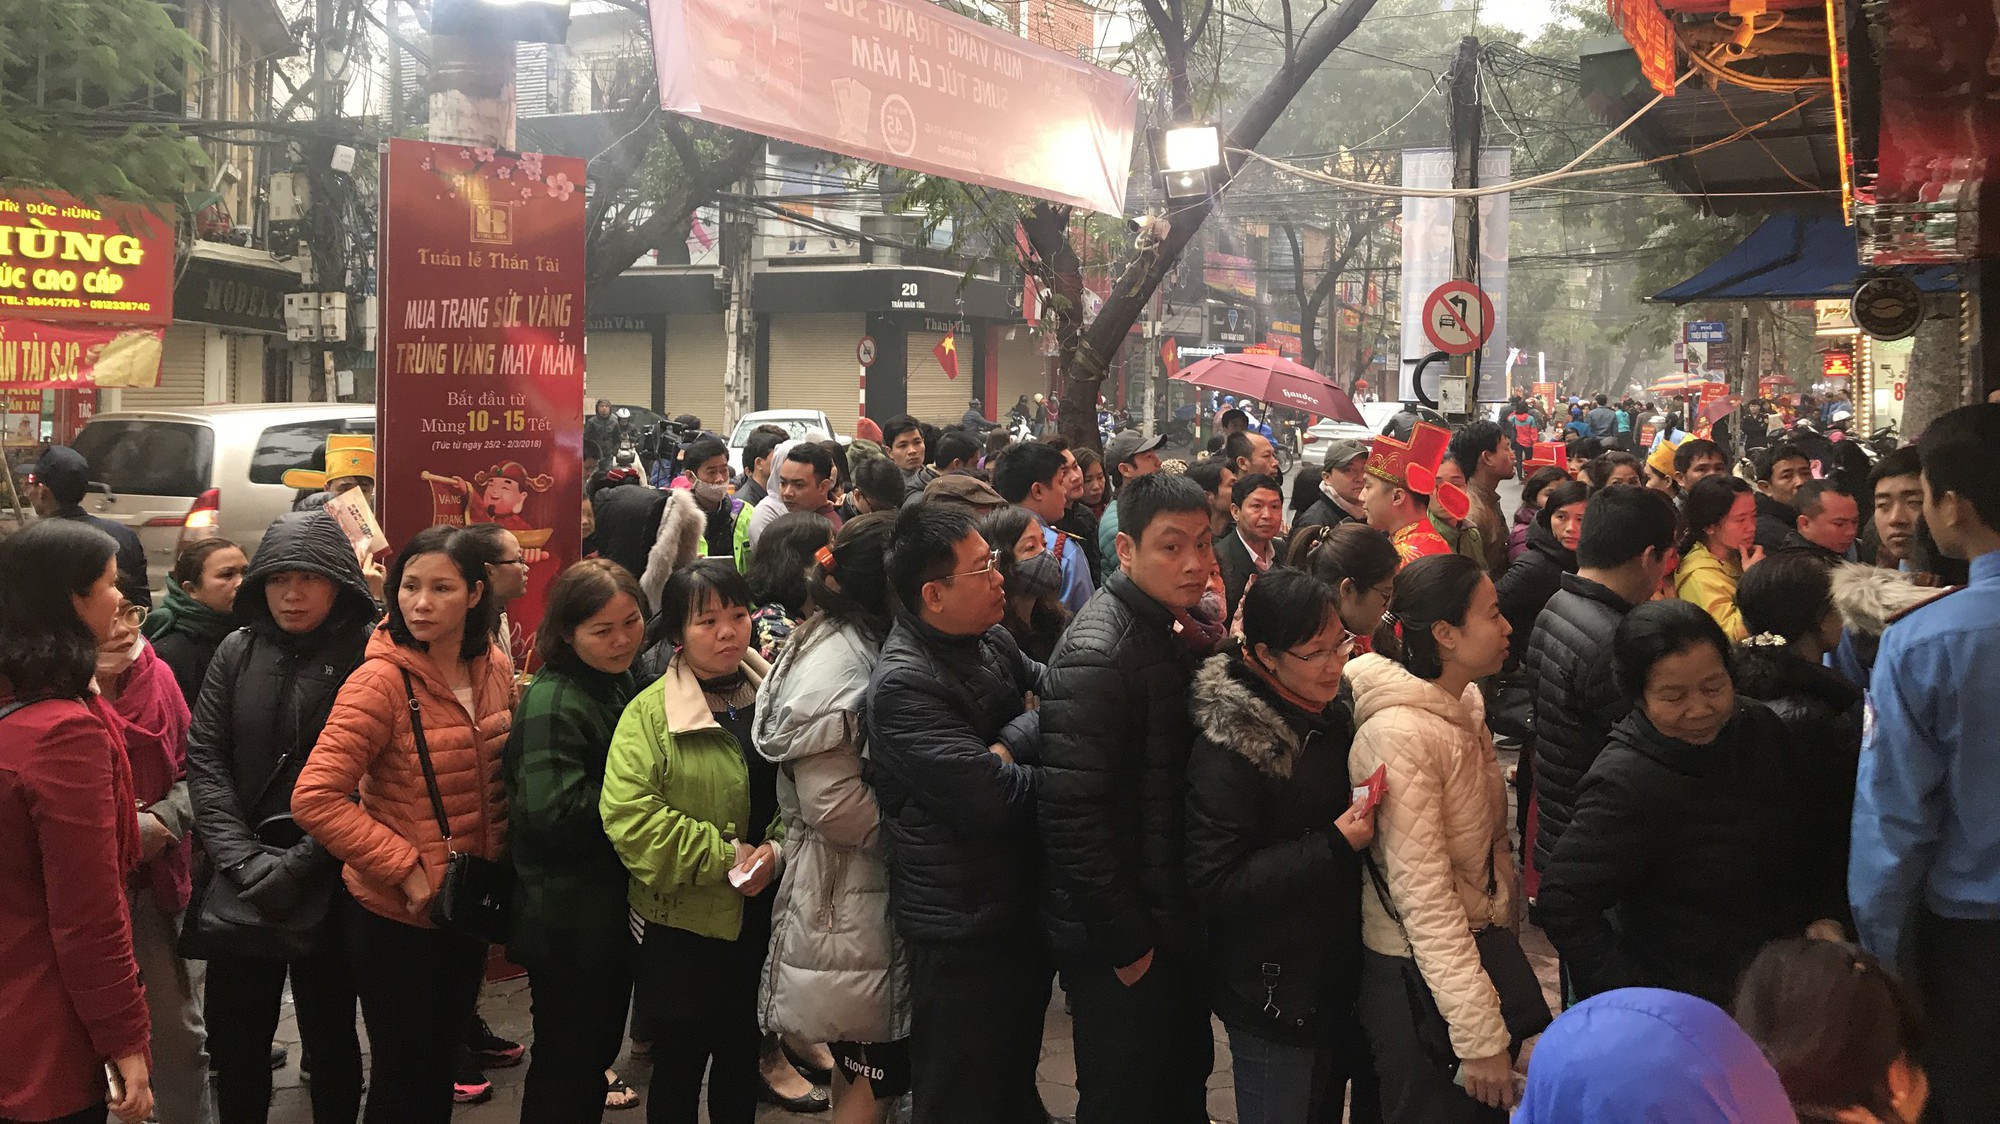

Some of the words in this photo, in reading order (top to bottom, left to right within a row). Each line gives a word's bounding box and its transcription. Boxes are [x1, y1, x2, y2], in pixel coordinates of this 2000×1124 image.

[26, 202, 57, 216] ĐỨC
[62, 206, 101, 220] HÙNG
[417, 248, 461, 267] Tuần
[468, 251, 482, 268] lễ
[489, 251, 529, 271] Thần
[535, 255, 560, 273] Tài
[32, 268, 77, 291] CAO
[83, 266, 123, 294] CẤP
[901, 283, 918, 297] 20
[0, 295, 24, 306] TEL:
[404, 300, 435, 330] MUA
[441, 297, 489, 329] TRANG
[528, 286, 573, 327] VÀNG
[21, 332, 46, 381] TÀI
[50, 341, 80, 382] SJC
[396, 335, 448, 375] TRÚNG
[452, 336, 496, 375] VÀNG
[500, 344, 536, 375] MAY
[539, 331, 576, 376] MẮN
[447, 389, 473, 406] Bắt
[478, 389, 505, 406] đầu
[510, 391, 526, 406] từ
[421, 418, 467, 435] Mùng
[466, 409, 489, 432] 10
[503, 409, 525, 432] 15
[527, 417, 551, 431] Tết
[463, 440, 482, 451] ngày
[484, 439, 501, 449] 25/2
[507, 439, 542, 449] 2/3/2018)
